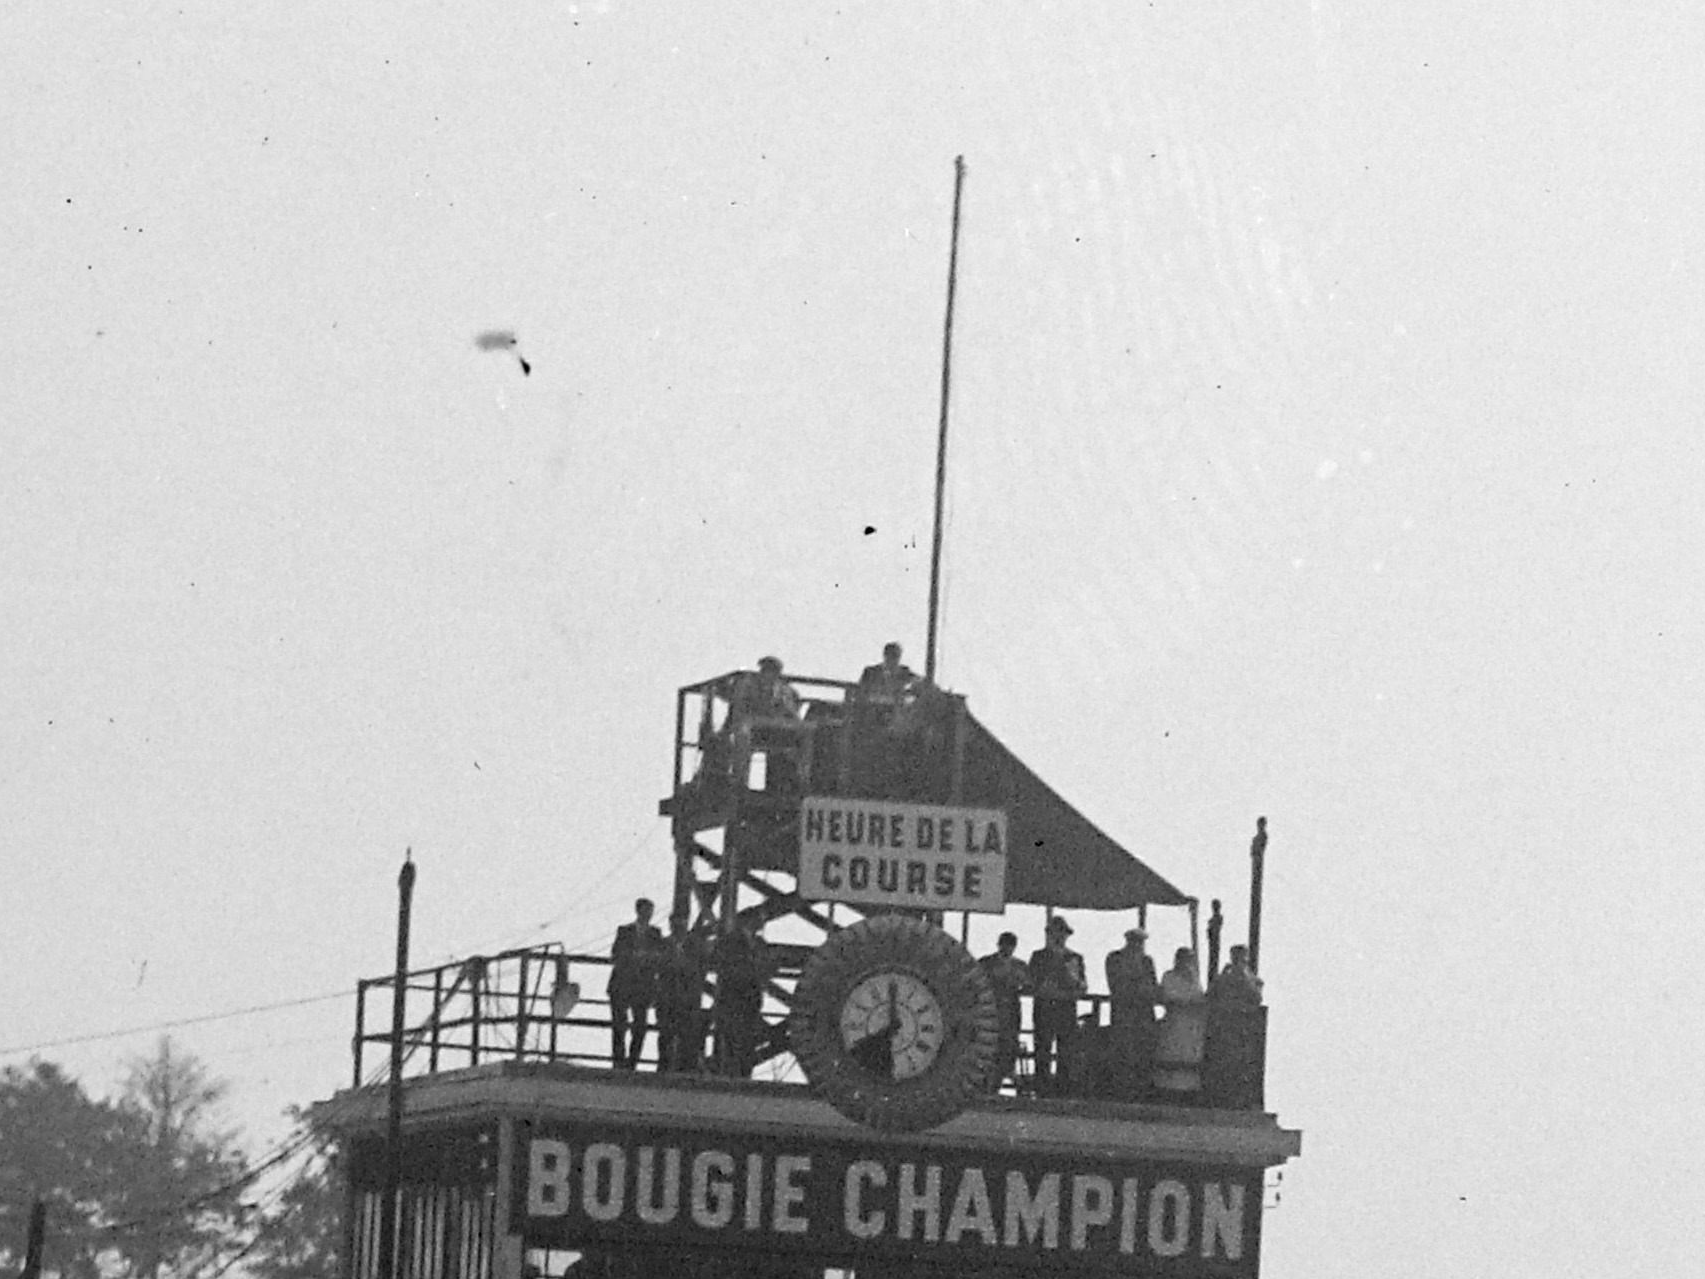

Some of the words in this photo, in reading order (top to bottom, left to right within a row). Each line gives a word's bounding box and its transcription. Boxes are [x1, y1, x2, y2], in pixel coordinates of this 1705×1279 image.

[805, 810, 905, 848] HEURE
[917, 815, 954, 851] DE
[965, 818, 1003, 855] LA
[821, 854, 982, 898] COURSE
[527, 1139, 811, 1232] BOUGIE
[844, 1160, 1246, 1260] CHAMPION
